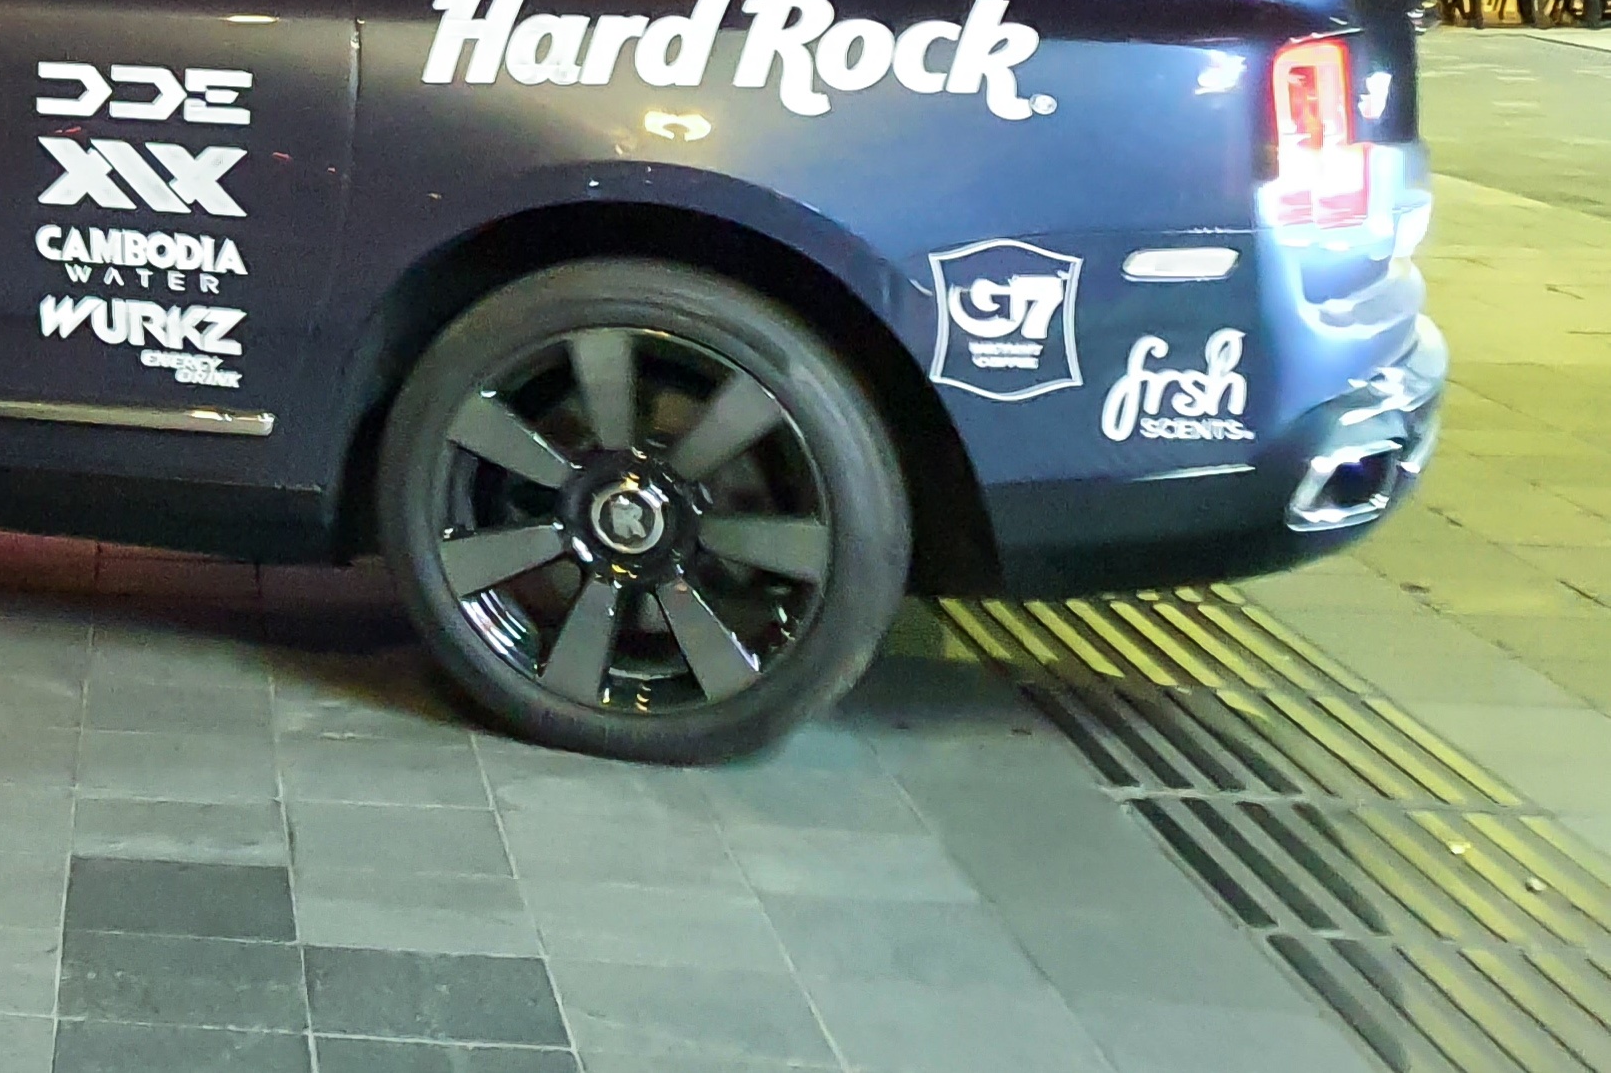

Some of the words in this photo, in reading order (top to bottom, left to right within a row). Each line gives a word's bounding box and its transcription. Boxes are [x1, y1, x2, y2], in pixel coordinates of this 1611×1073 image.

[35, 224, 249, 275] CAMBODIA
[64, 262, 220, 294] WATER
[948, 273, 1064, 339] G7
[40, 294, 248, 355] WURKZ
